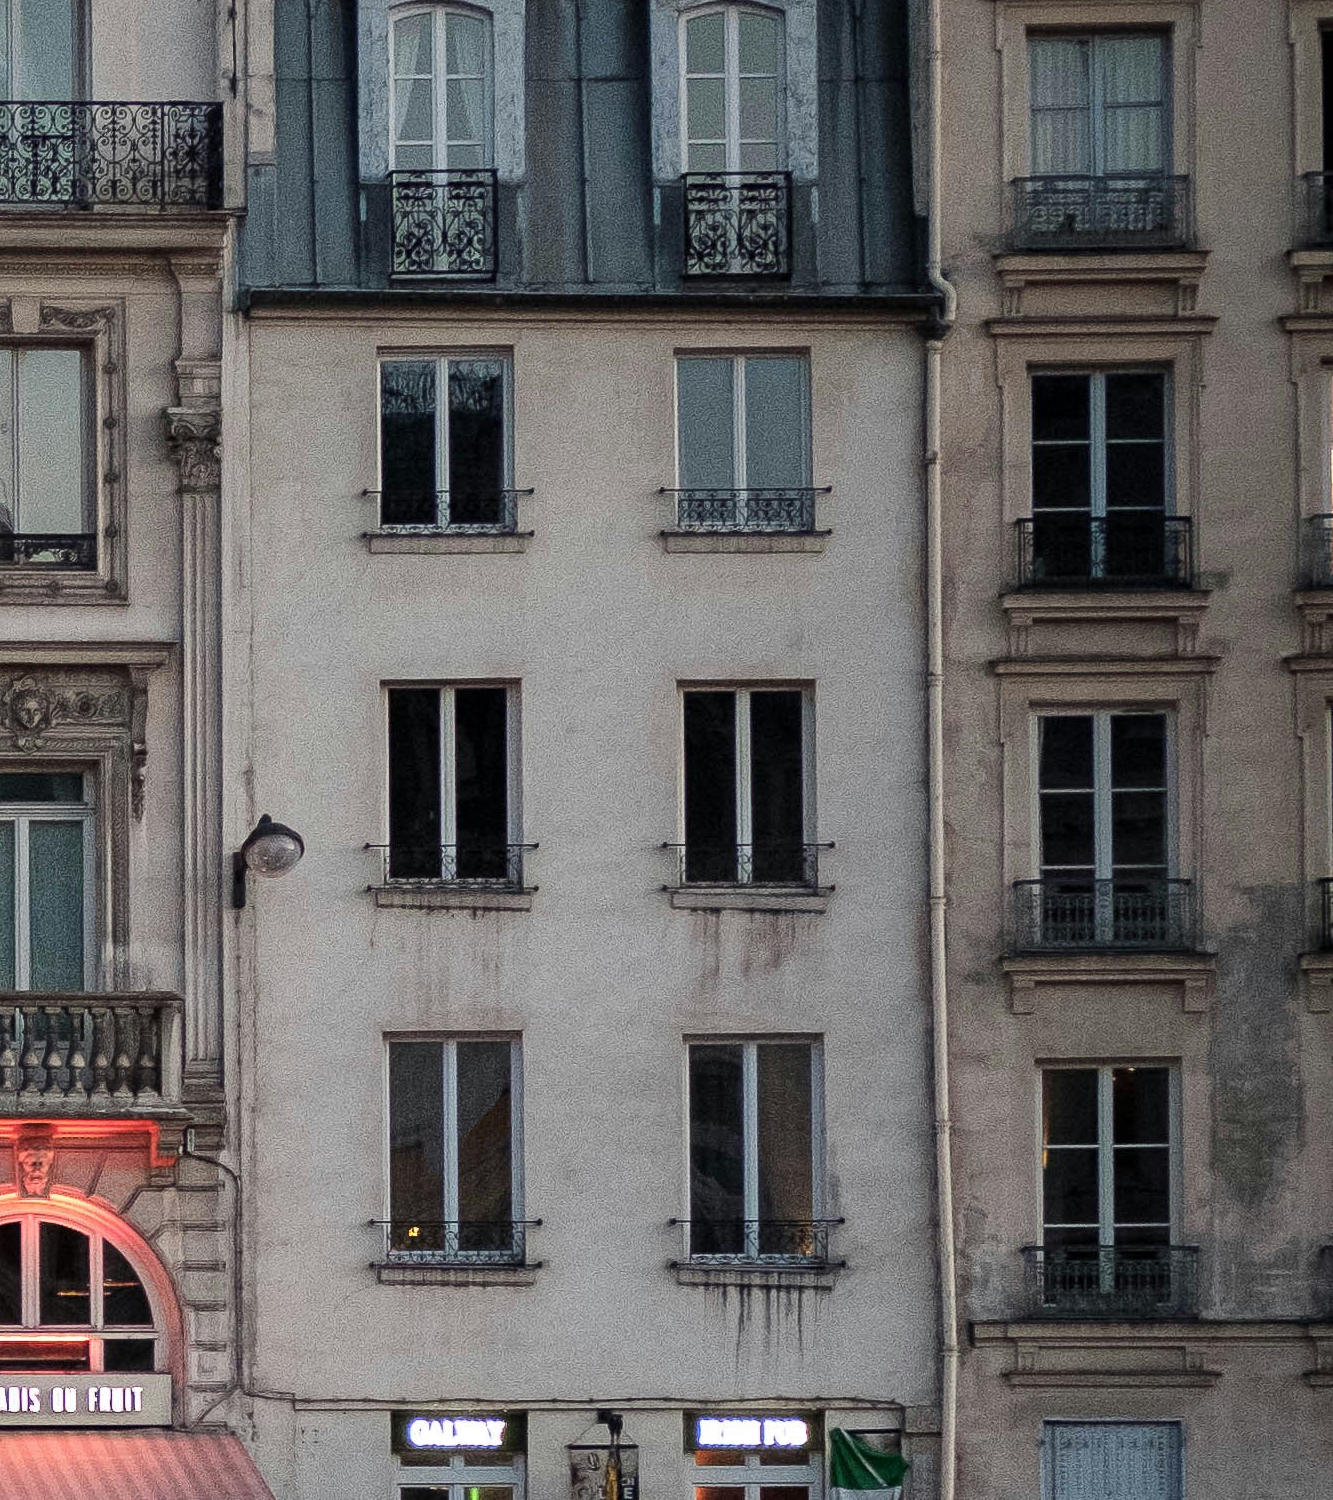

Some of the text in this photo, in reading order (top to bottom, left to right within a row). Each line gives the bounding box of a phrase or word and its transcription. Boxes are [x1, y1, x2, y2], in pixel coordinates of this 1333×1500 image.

[51, 1386, 77, 1413] DU
[87, 1386, 144, 1413] FRUIT
[408, 1417, 507, 1448] GALWAY
[697, 1417, 809, 1447] IRISH PUB
